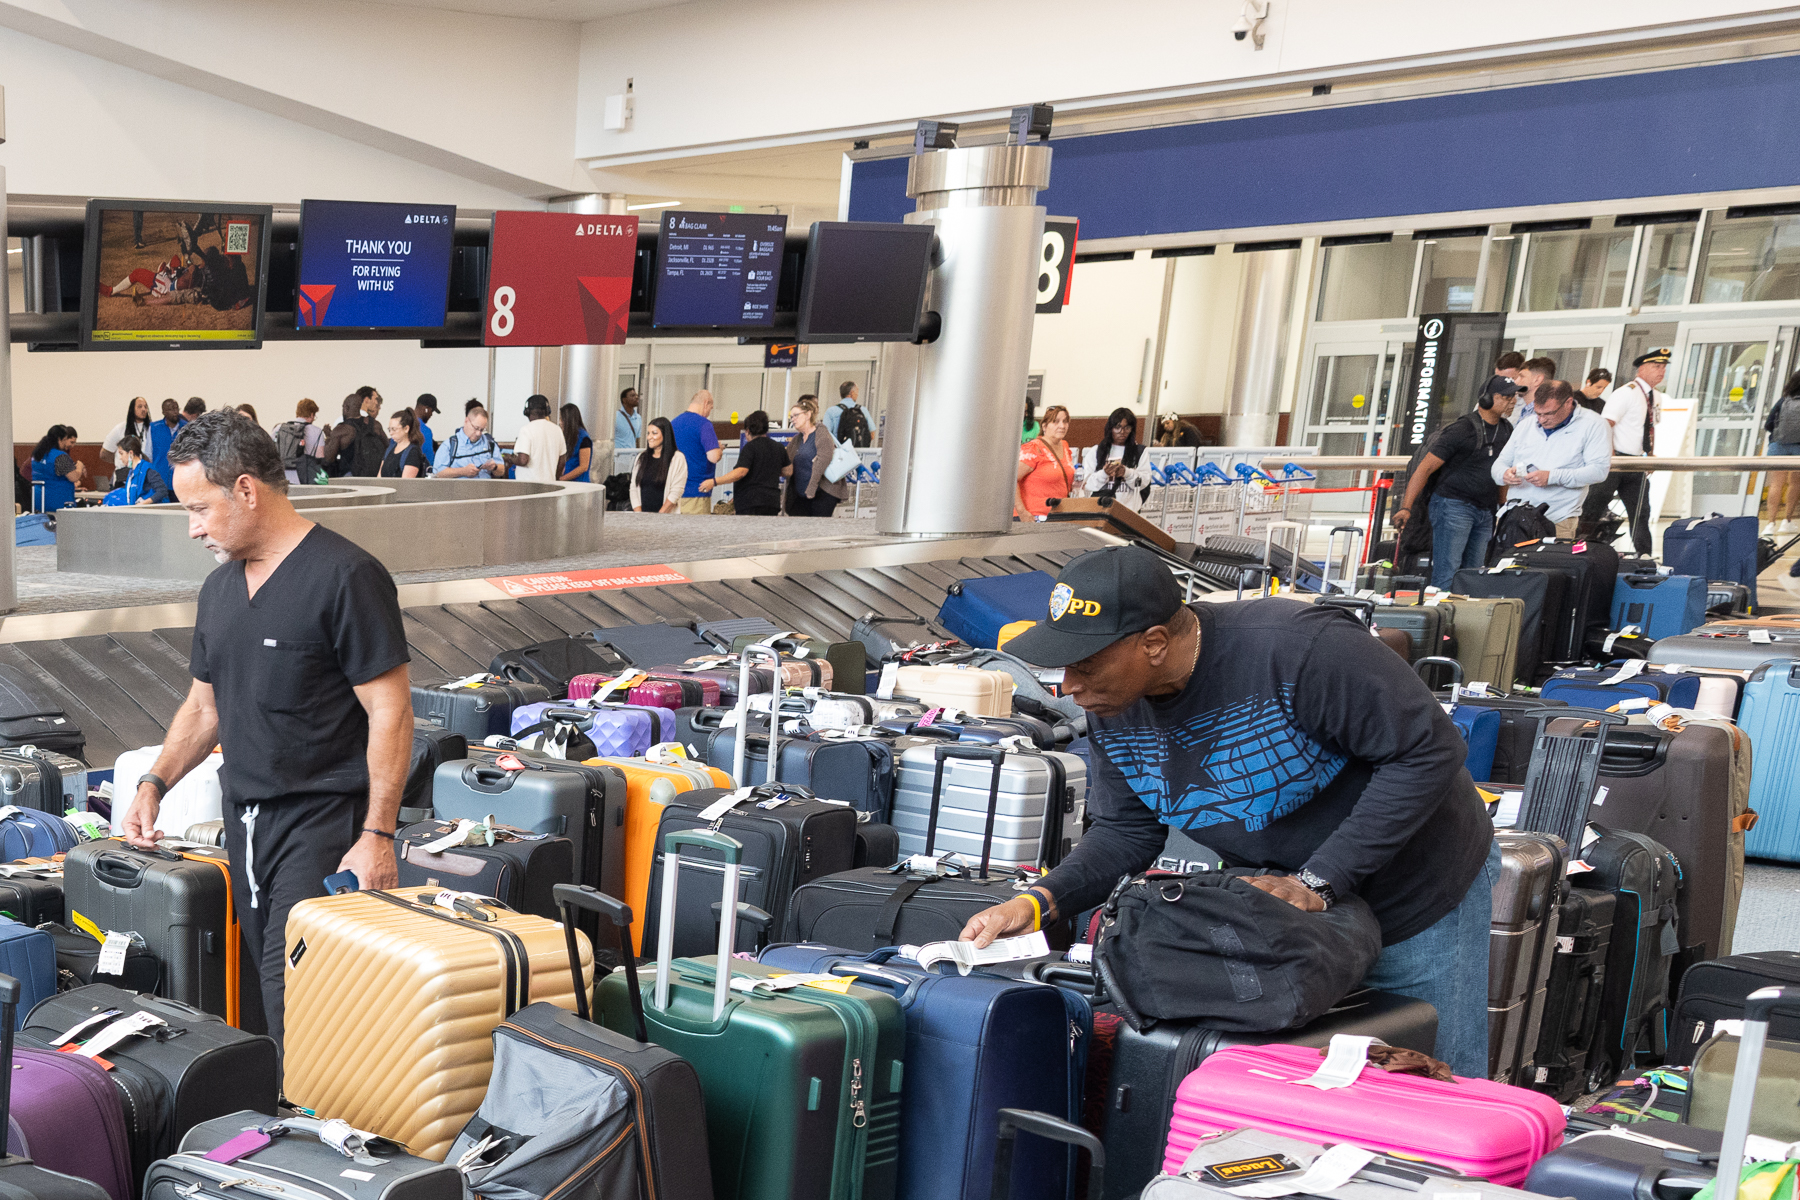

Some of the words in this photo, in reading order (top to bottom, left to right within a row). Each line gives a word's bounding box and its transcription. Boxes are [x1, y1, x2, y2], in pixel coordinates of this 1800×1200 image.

[414, 215, 441, 224] DELTA
[669, 217, 676, 229] 8
[587, 224, 623, 236] DELTA
[345, 239, 385, 254] THANK
[387, 241, 412, 255] YOU
[352, 266, 370, 277] FOR
[371, 266, 401, 277] FLYING
[1036, 231, 1066, 304] 8
[357, 280, 382, 291] WITH
[382, 280, 394, 291] US
[490, 286, 516, 337] 8
[1410, 341, 1439, 445] INFORMATION
[523, 575, 573, 585] CAUTION:
[532, 581, 573, 592] PLEASE
[571, 580, 593, 590] KEEP
[593, 579, 610, 587] OFF
[611, 577, 632, 586] BAG
[632, 573, 686, 585] CAROUSELS
[1067, 597, 1102, 617] PD
[1244, 788, 1315, 832] ORLANDO
[1222, 1160, 1278, 1177] Lucas
